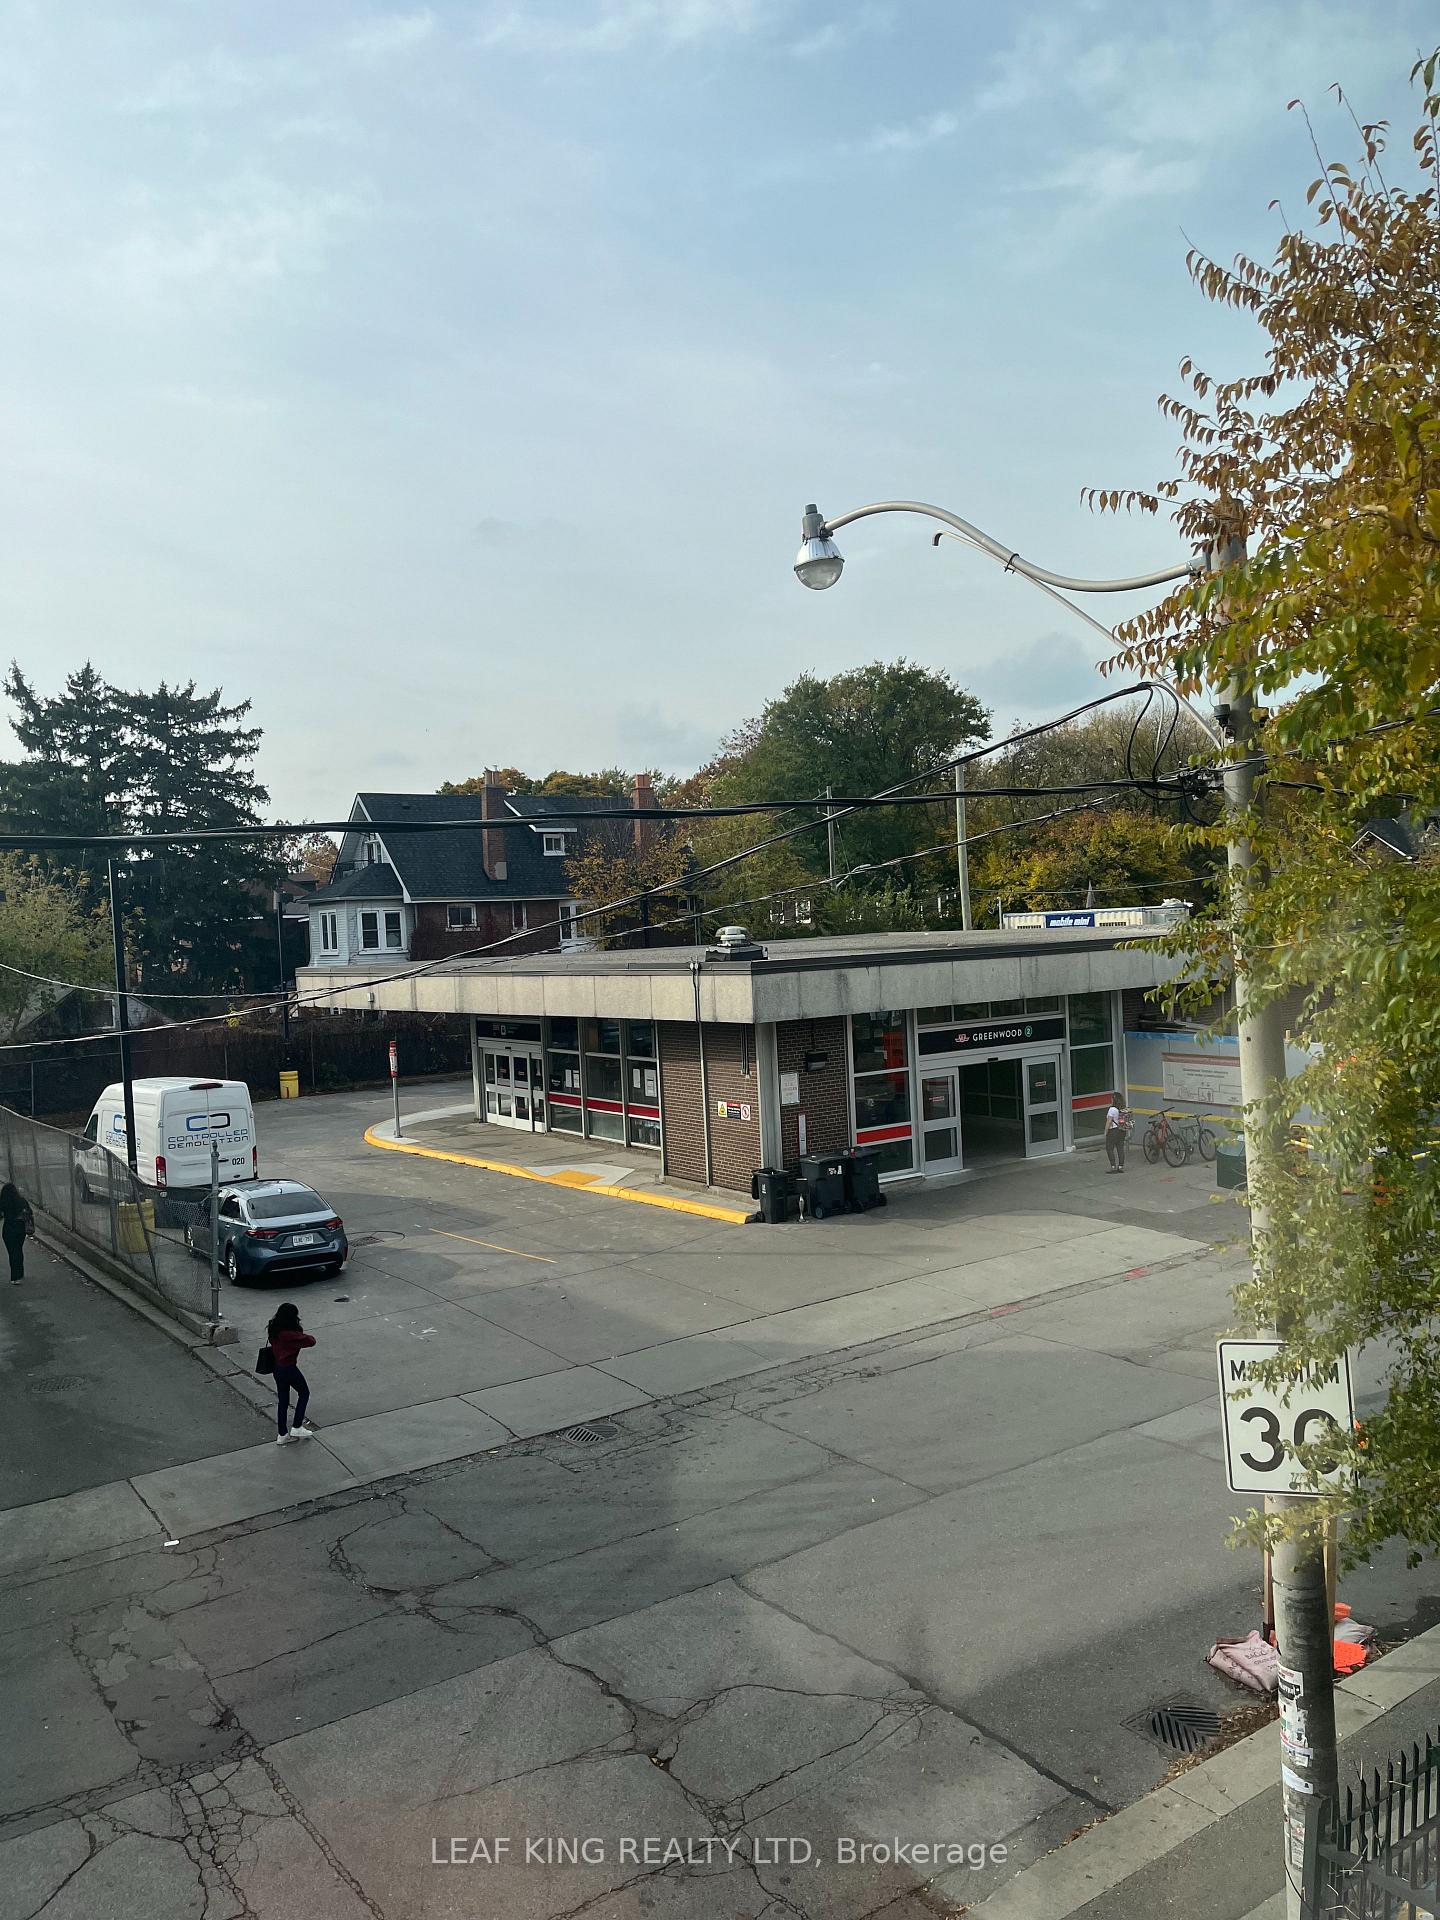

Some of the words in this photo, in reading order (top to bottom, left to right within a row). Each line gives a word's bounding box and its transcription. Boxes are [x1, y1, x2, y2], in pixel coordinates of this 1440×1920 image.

[972, 1028, 1023, 1042] GREENWOOD
[168, 1128, 248, 1143] CONTROLLED
[232, 1157, 245, 1165] 020
[1239, 1406, 1342, 1475] 30
